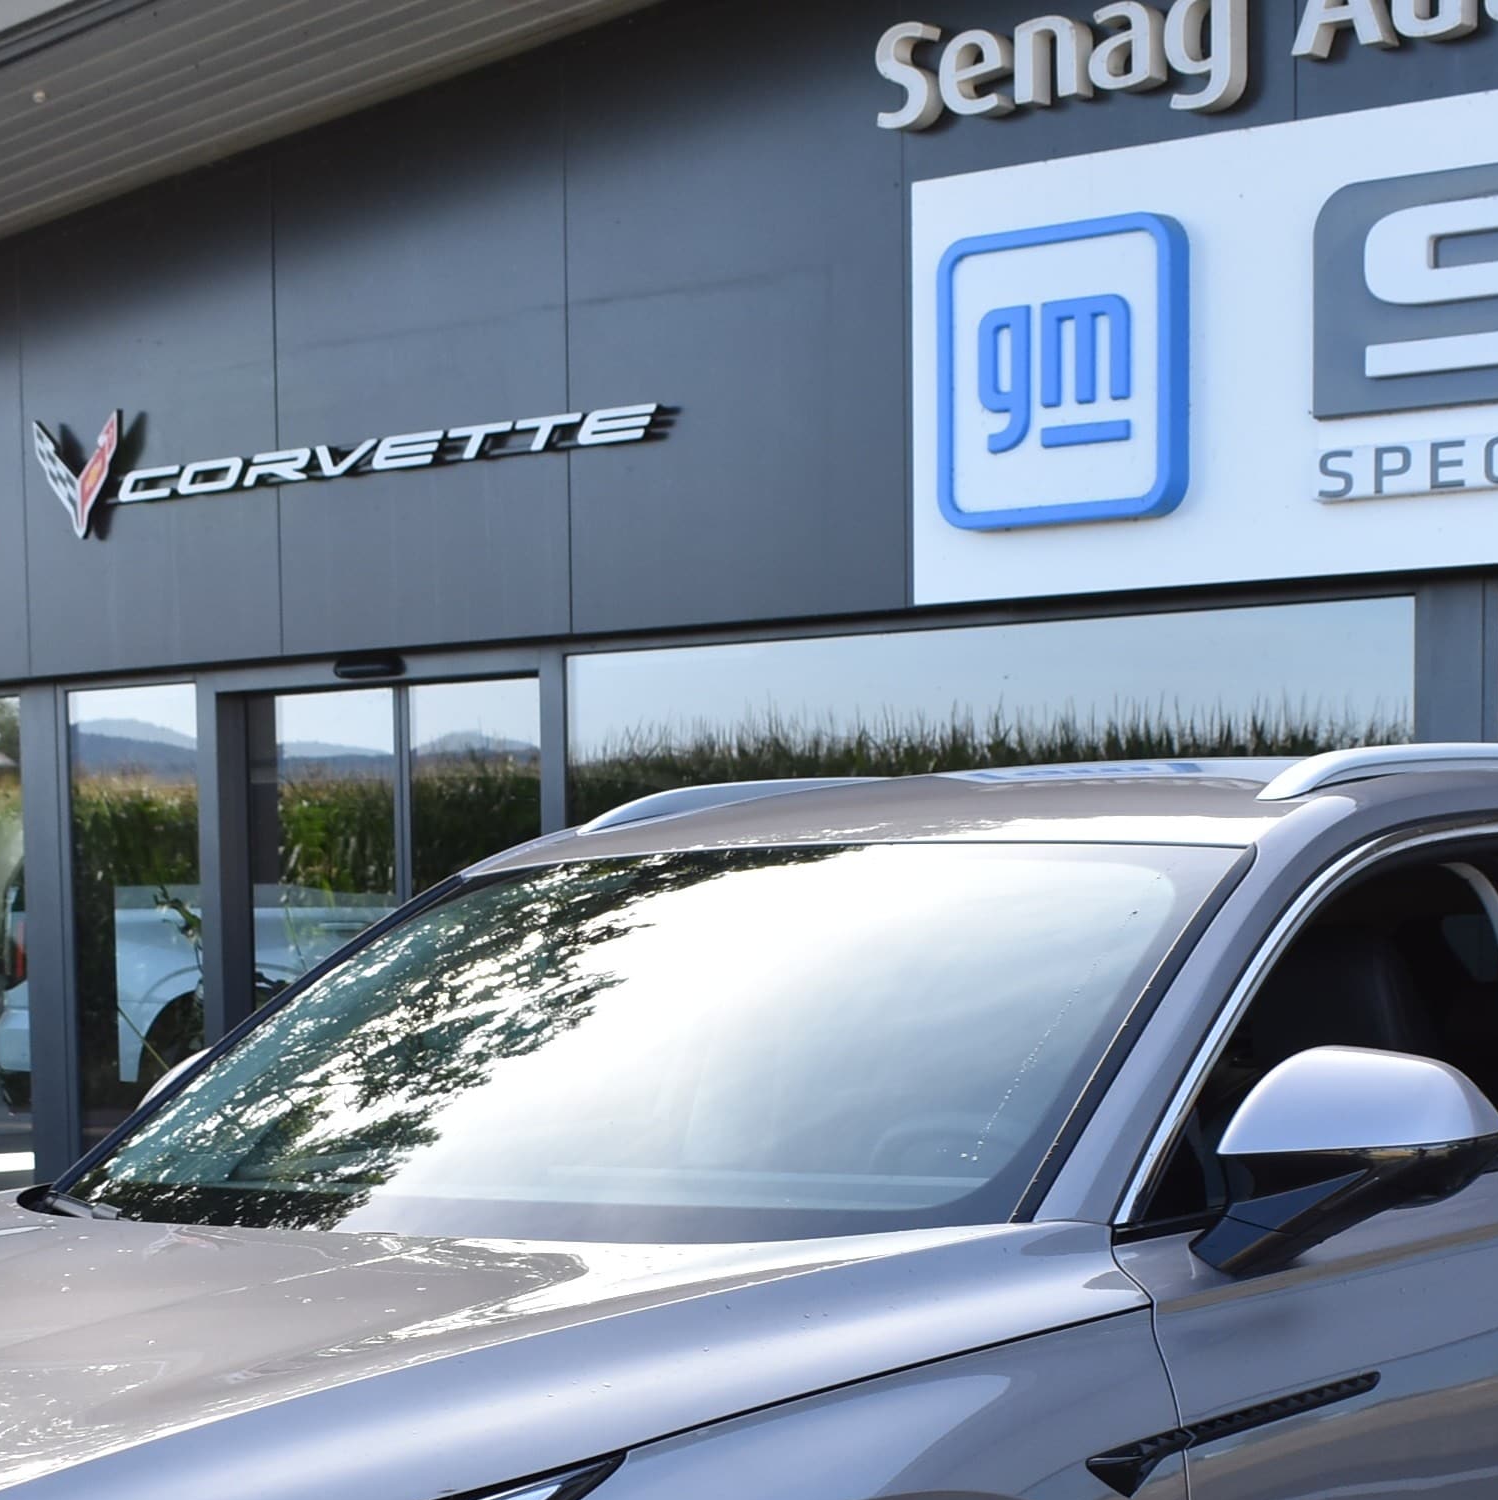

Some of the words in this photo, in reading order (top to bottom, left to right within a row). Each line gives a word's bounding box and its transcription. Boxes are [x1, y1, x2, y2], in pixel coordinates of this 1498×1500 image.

[875, 0, 1248, 132] Senag
[977, 292, 1133, 453] gm
[116, 402, 658, 504] CORVETTE
